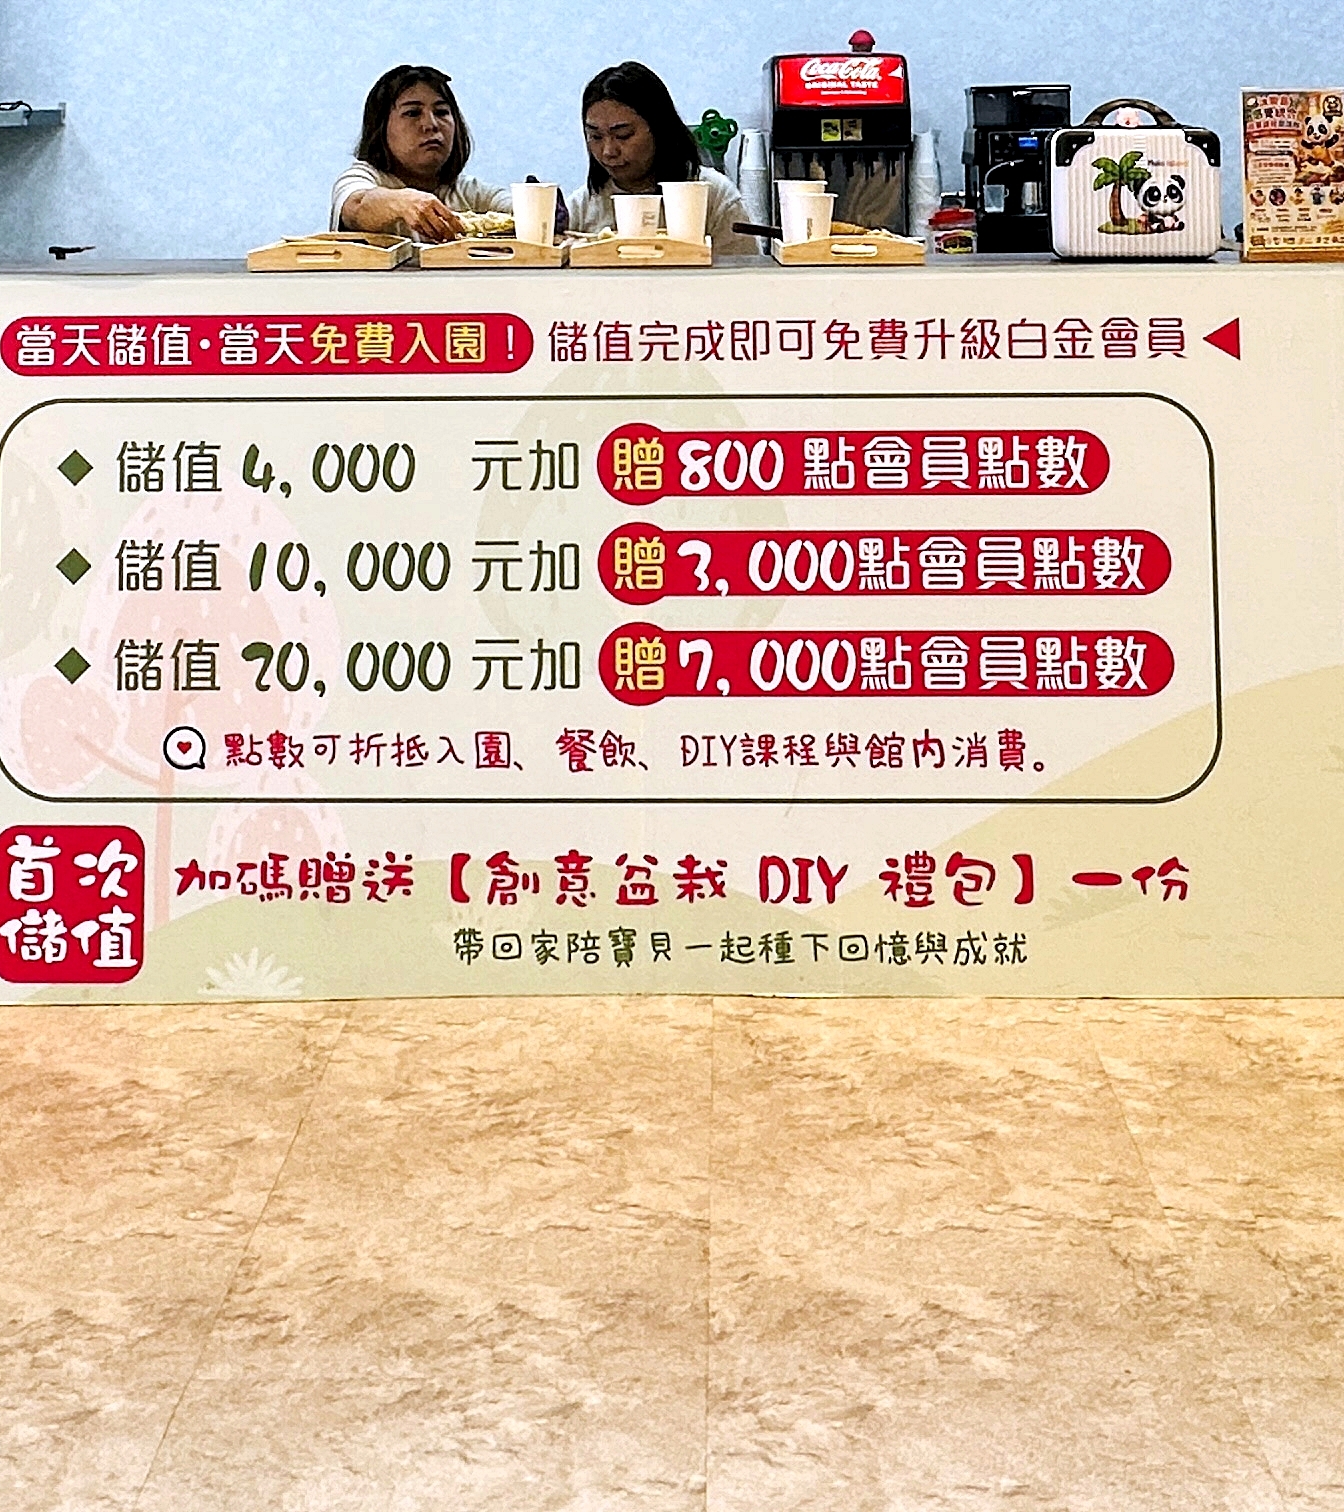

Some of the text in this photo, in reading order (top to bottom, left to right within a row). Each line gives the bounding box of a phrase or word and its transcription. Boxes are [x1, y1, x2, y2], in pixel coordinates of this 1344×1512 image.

[549, 317, 1187, 364] 儲值完成即可免費升級白金會員
[116, 439, 222, 495] 儲值
[677, 439, 786, 493] 800
[803, 436, 1087, 491] 點會員點數
[116, 539, 222, 594] 儲值
[115, 638, 222, 694] 儲值
[7, 835, 138, 902] 首次
[758, 855, 848, 904] DIY
[452, 929, 1028, 967] 帶回家陪寶貝一起種下回憶與成就
